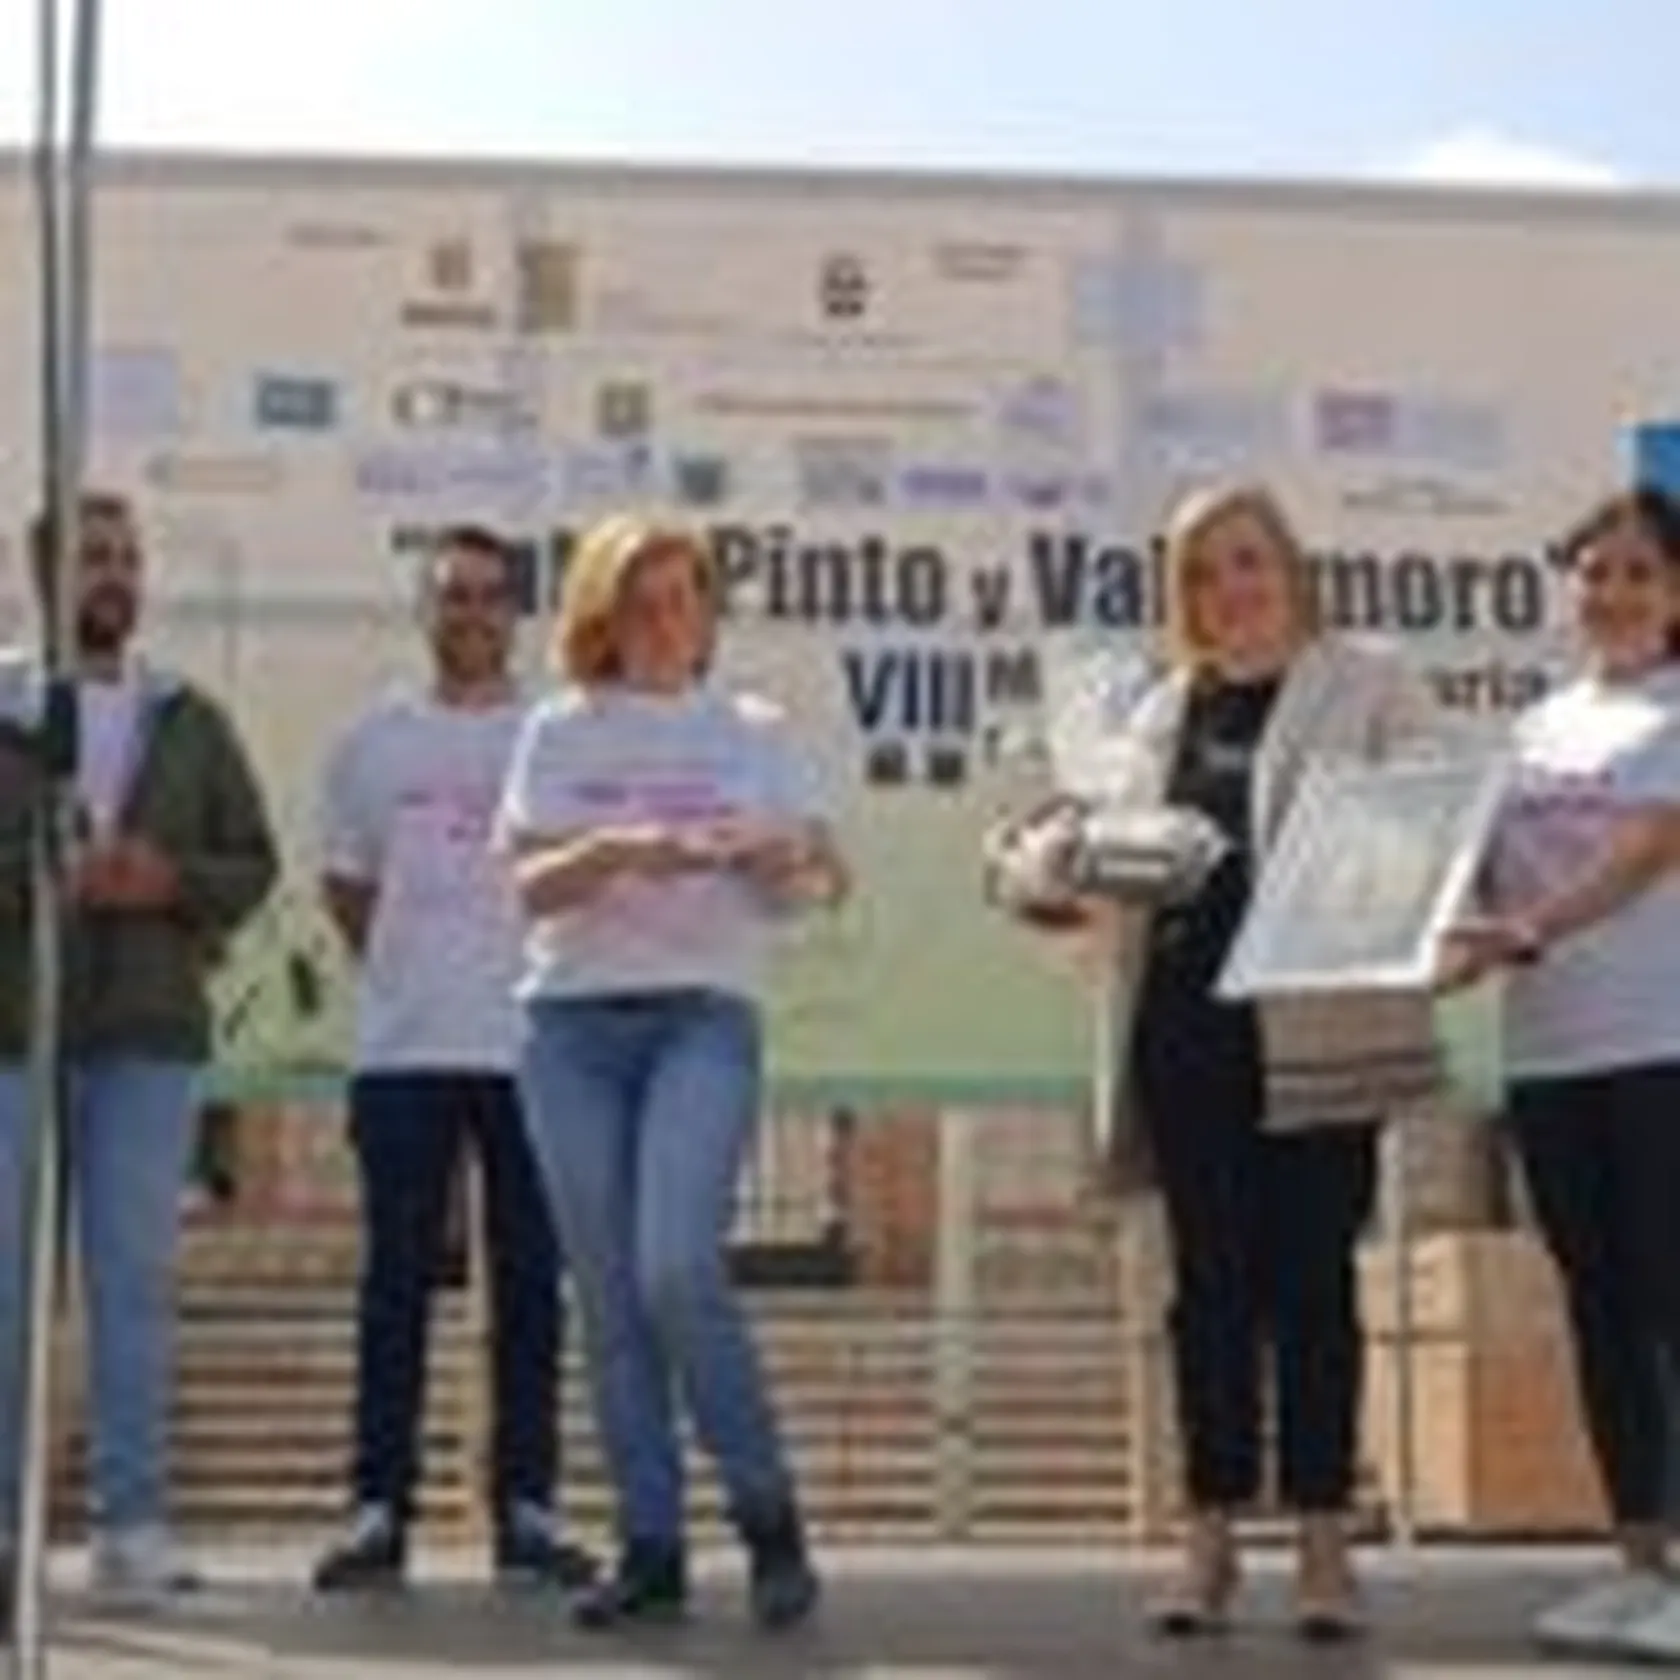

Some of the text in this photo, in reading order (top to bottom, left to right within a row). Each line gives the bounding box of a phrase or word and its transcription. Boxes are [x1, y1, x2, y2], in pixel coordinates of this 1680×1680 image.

[712, 526, 946, 628] Pinto
[970, 567, 1012, 632] y
[843, 648, 976, 733] VIII
